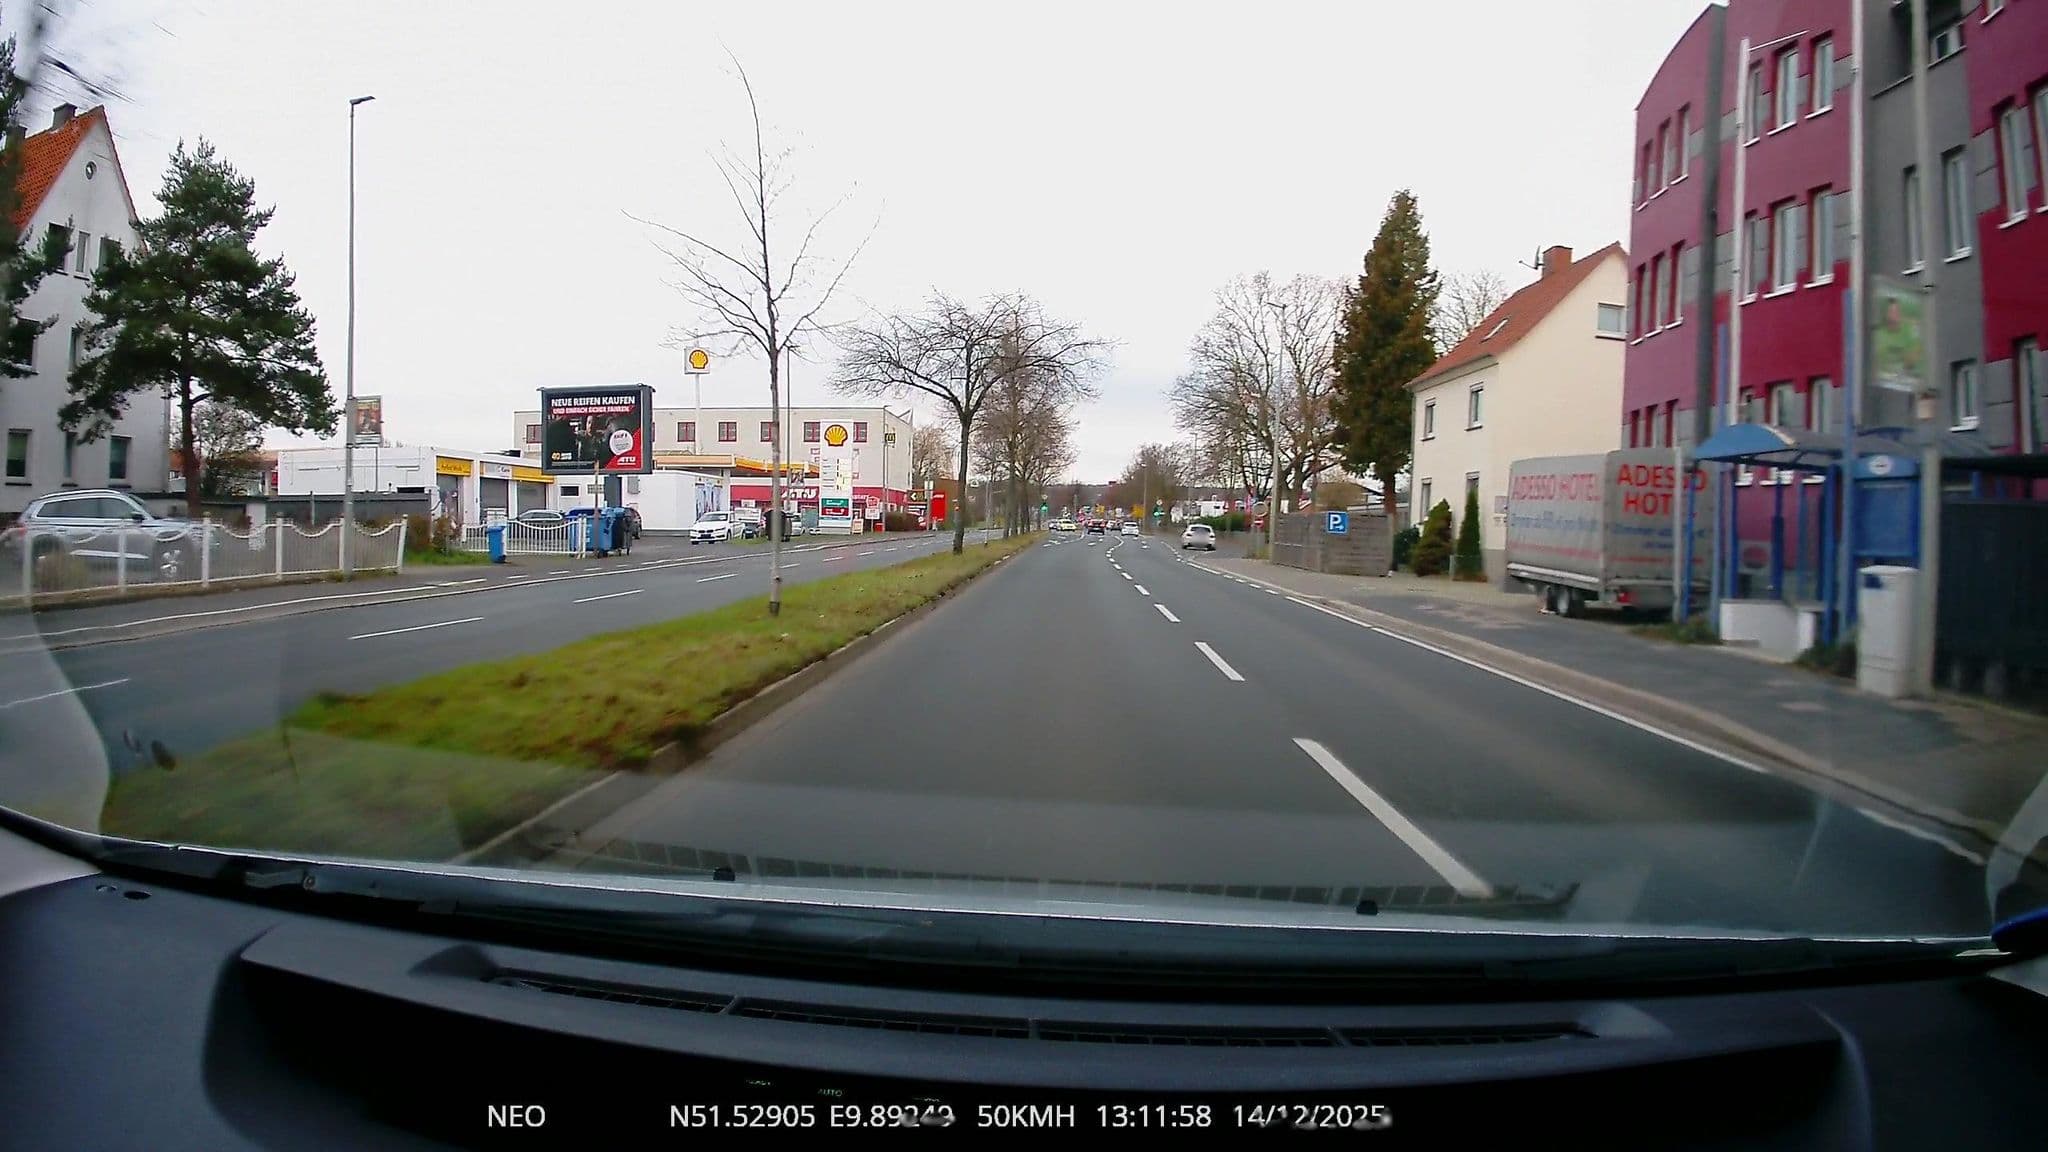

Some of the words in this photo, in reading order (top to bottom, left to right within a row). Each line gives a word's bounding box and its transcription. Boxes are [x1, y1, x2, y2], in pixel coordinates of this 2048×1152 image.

[551, 398, 572, 407] NEUE
[573, 397, 601, 406] REIFEN
[602, 396, 636, 405] KAUFEN
[1511, 474, 1556, 501] ADESSO
[1559, 473, 1601, 502] HOTEL
[1329, 514, 1342, 530] P
